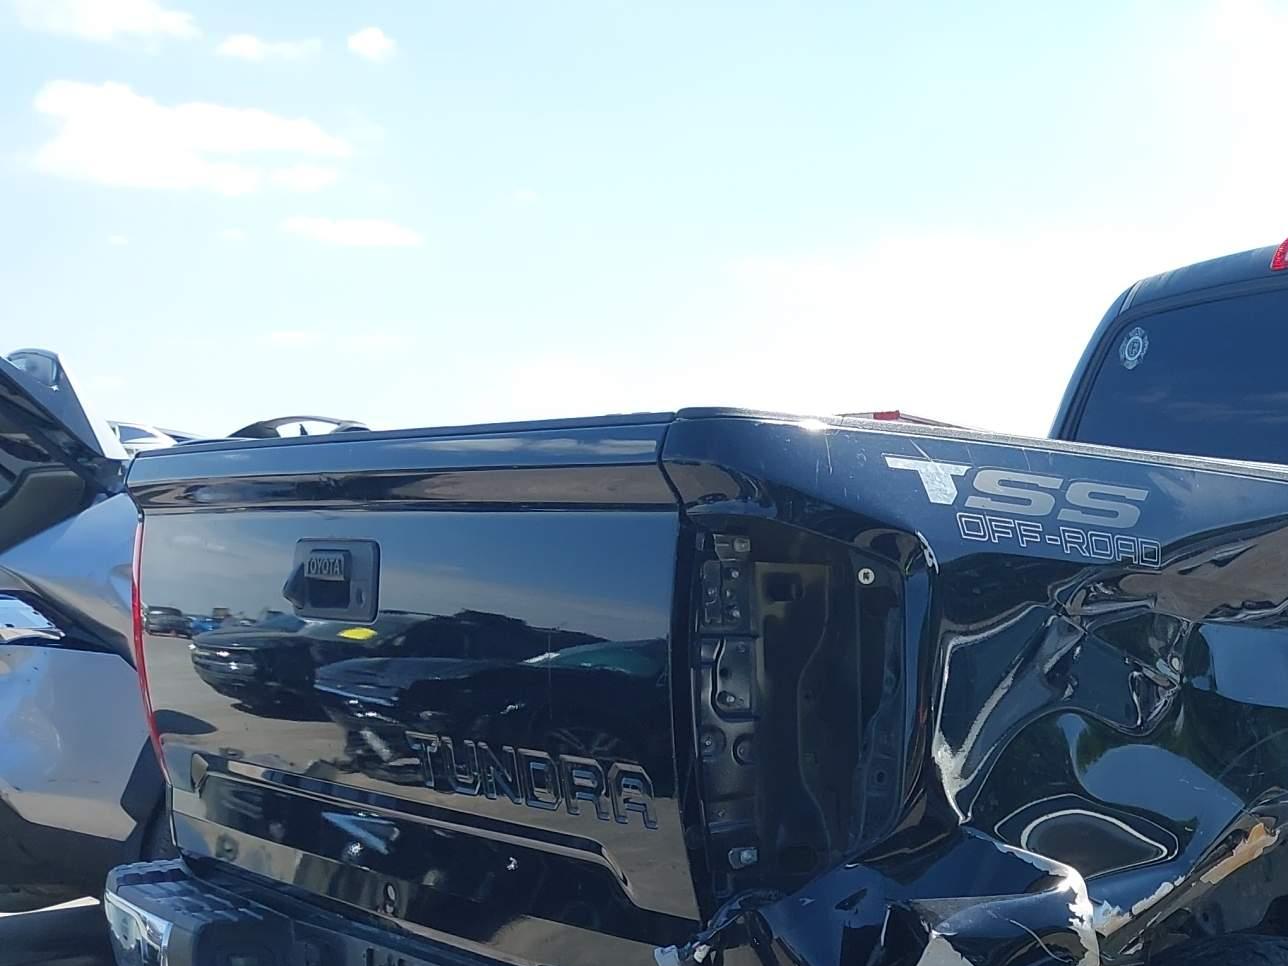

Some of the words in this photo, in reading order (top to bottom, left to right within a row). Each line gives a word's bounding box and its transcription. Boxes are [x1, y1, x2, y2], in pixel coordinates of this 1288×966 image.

[304, 557, 342, 578] TOYOTA
[956, 511, 1162, 568] OFF-ROAD
[405, 730, 659, 830] TUNDRA
